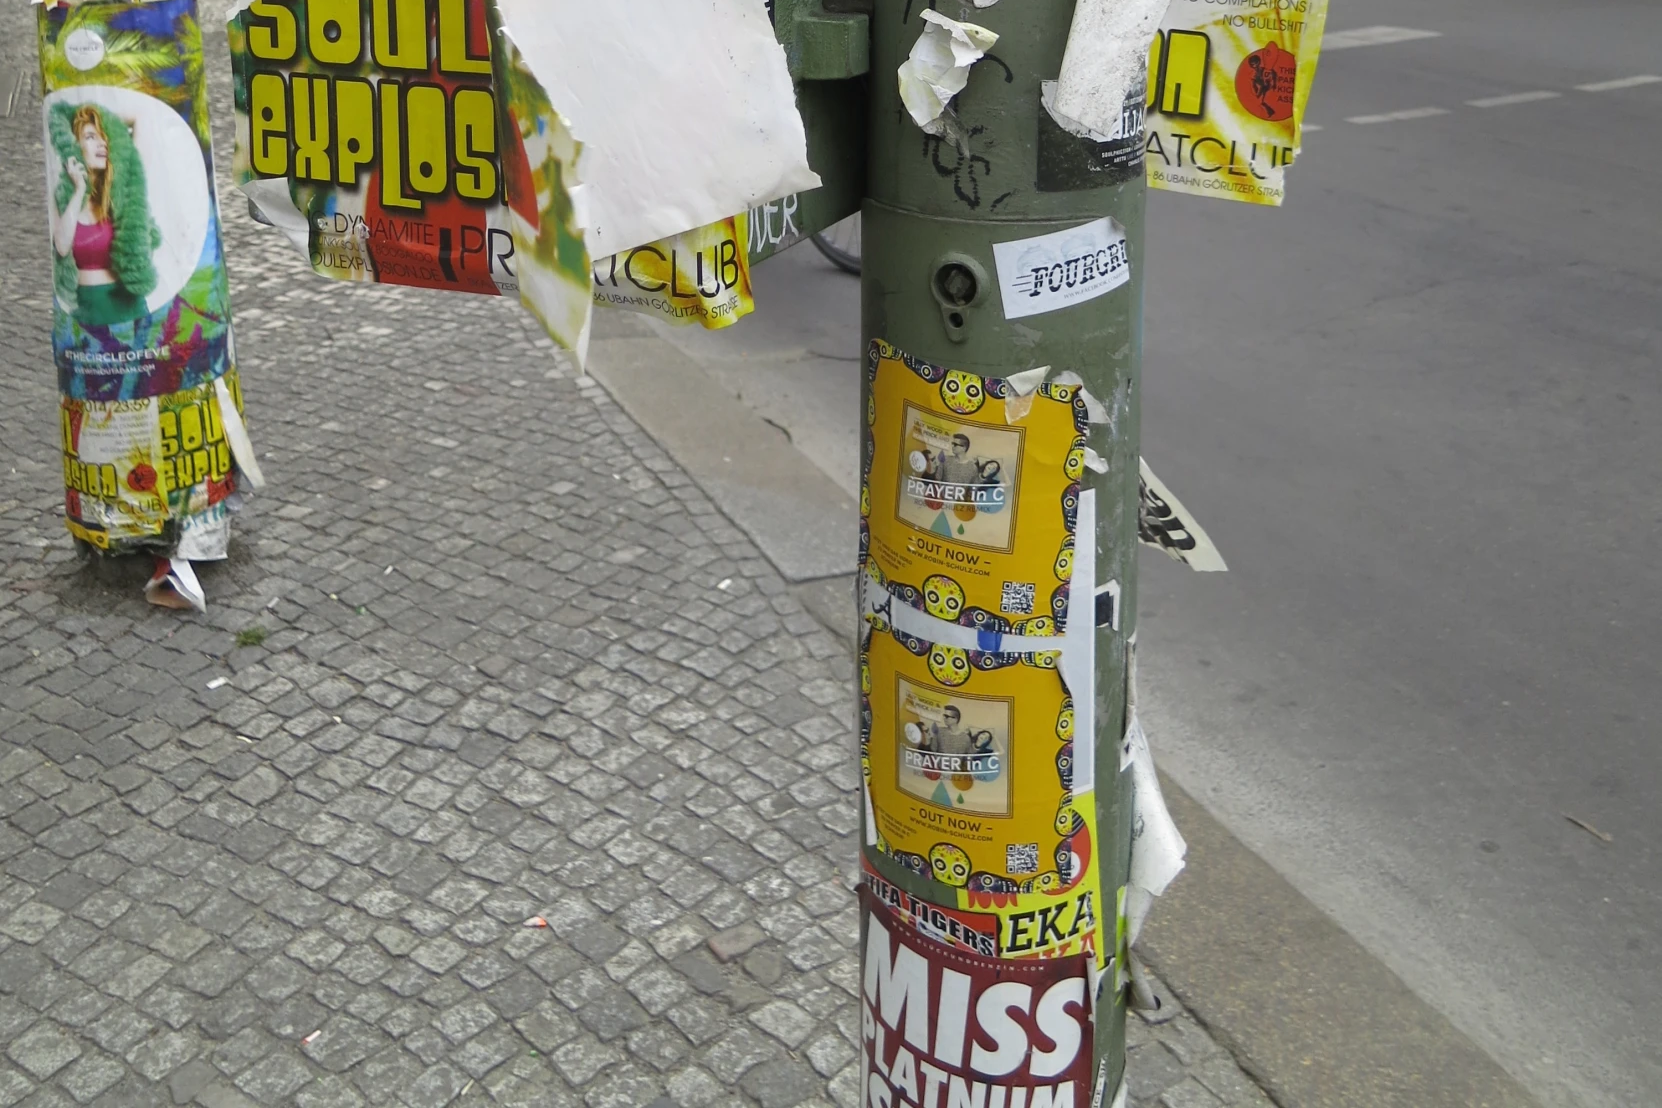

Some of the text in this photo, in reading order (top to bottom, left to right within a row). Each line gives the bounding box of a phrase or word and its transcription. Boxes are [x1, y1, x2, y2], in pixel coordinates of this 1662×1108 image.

[1222, 13, 1245, 29] NO
[1166, 171, 1200, 188] UBAHN
[1202, 175, 1256, 195] GÖRLITZER
[608, 294, 649, 307] UBAHN
[651, 297, 708, 320] GÖRLITZER
[907, 480, 1004, 501] PRAYER in C
[916, 538, 942, 556] OUT
[945, 548, 980, 566] NOW
[905, 751, 999, 771] PRAYER in C
[919, 807, 944, 825] OUT
[947, 819, 982, 833] NOW
[907, 894, 994, 958] TIGERS
[864, 910, 1087, 1077] MISS
